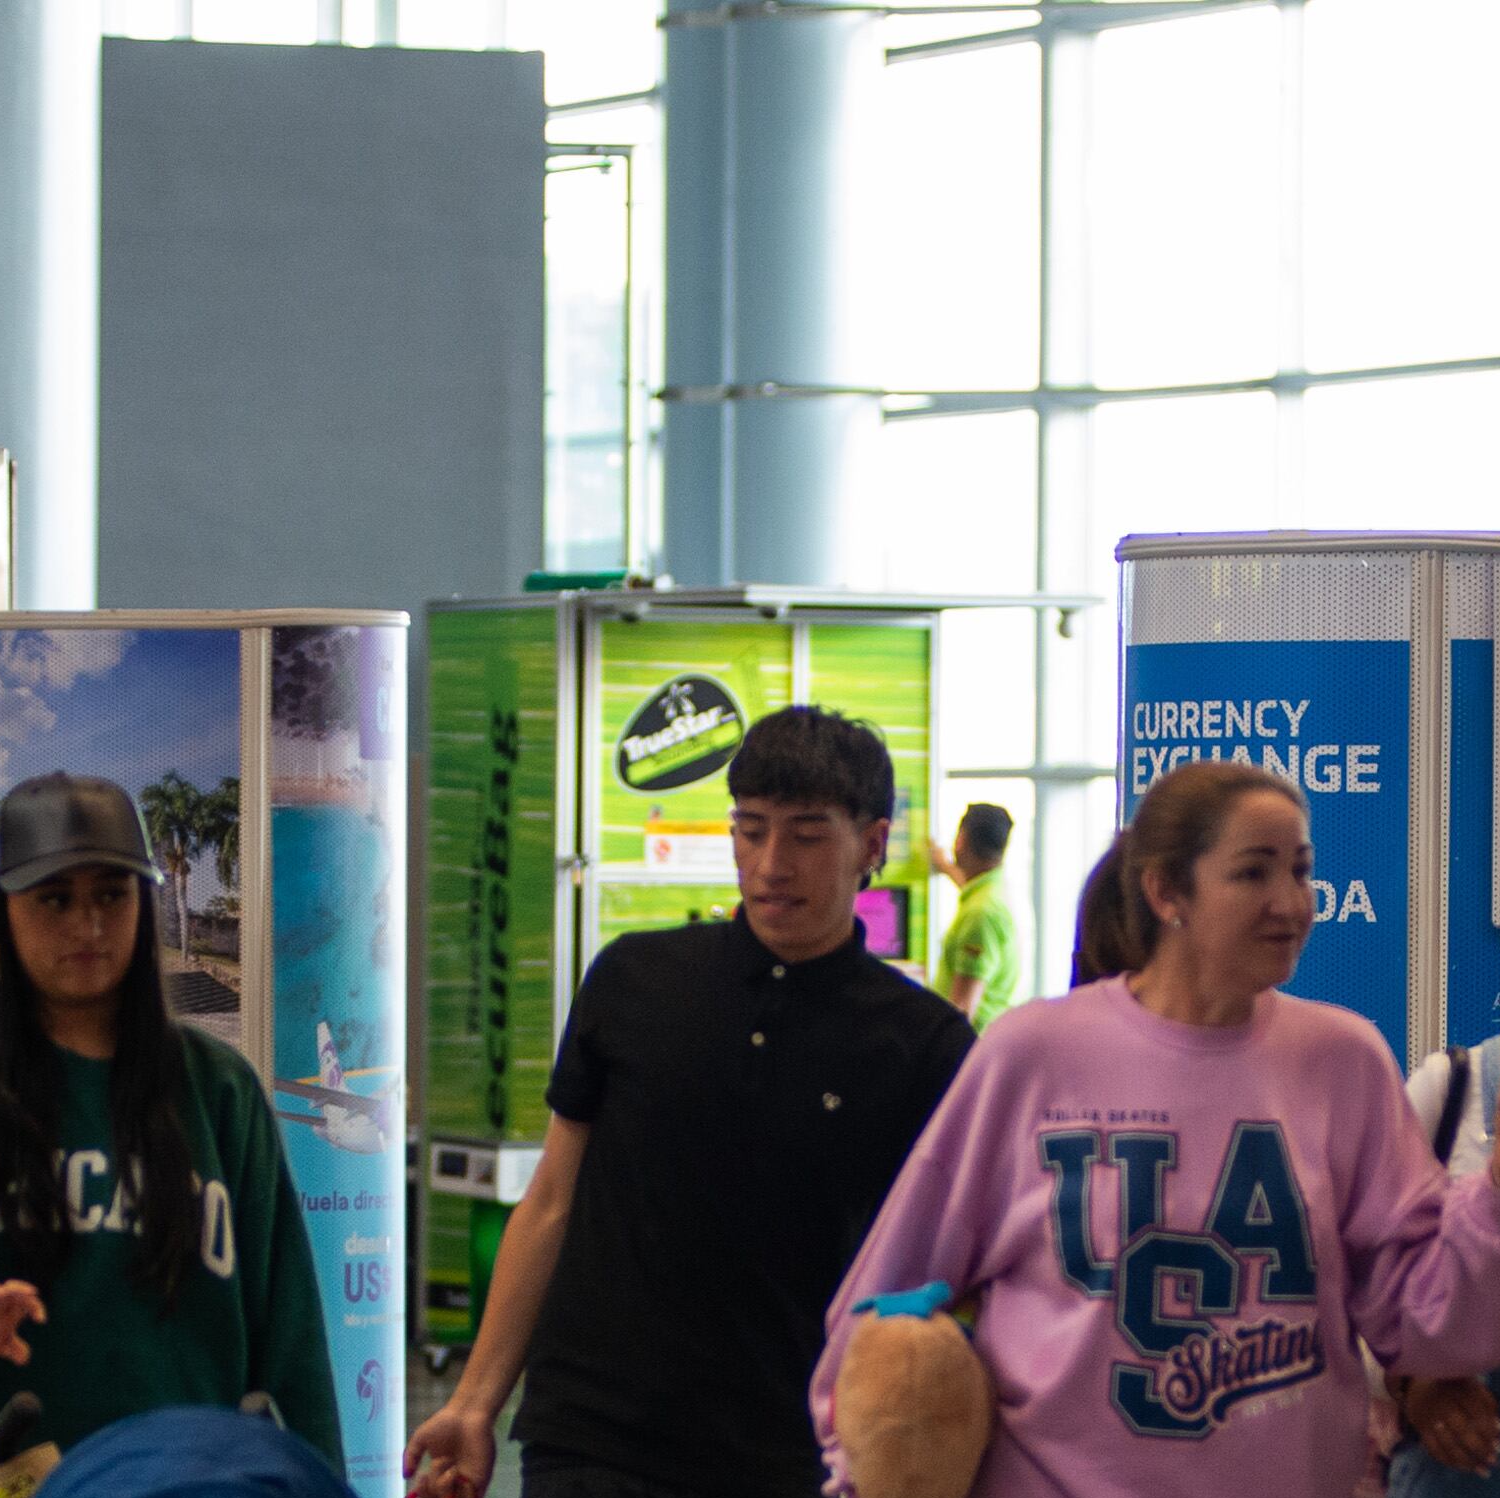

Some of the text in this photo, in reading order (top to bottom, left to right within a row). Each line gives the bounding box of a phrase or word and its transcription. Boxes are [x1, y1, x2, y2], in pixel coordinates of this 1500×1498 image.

[622, 704, 725, 763] TrueStar
[1132, 699, 1311, 741] CURRENCY
[483, 706, 518, 1129] ecureBag
